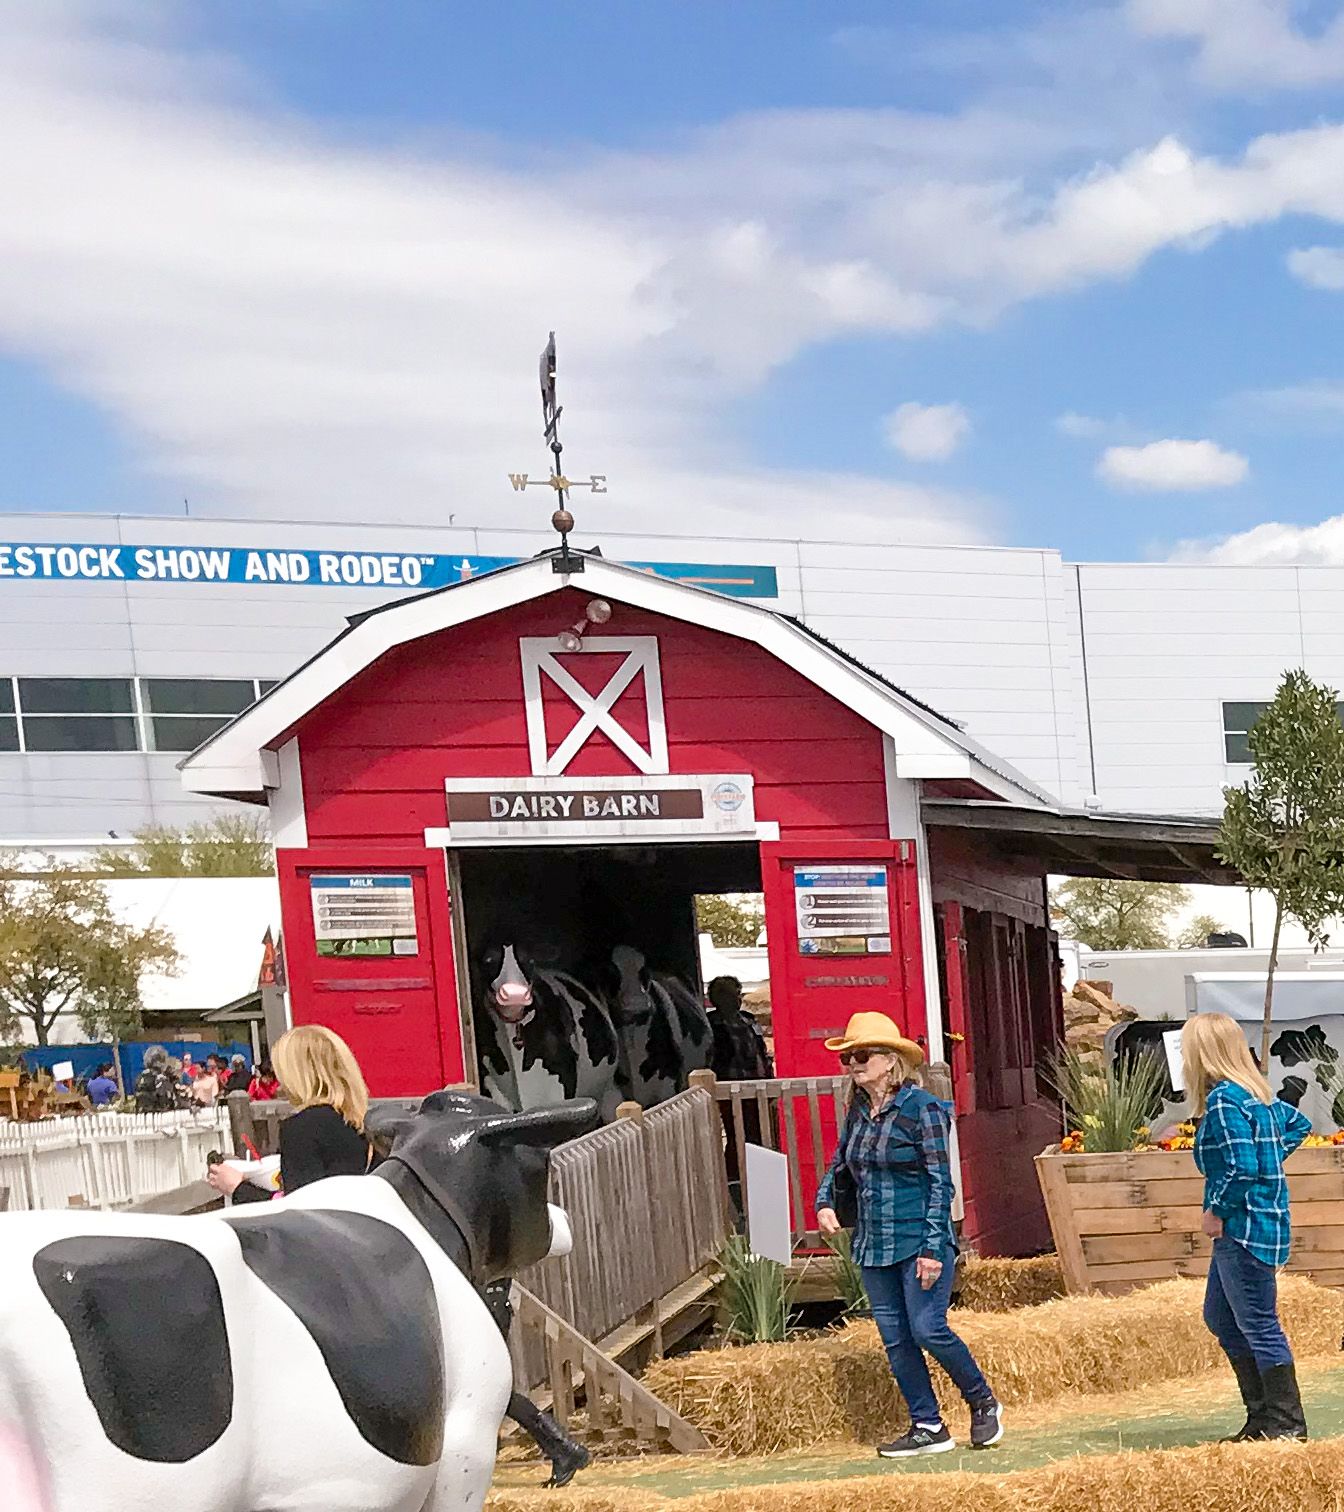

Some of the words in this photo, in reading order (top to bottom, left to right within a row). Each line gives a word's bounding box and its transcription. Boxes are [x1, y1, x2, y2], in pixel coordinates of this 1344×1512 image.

[134, 549, 231, 579] SHOW
[245, 552, 310, 581] AND
[489, 795, 574, 818] DAIRY
[583, 794, 660, 816] BARN
[349, 879, 374, 887] MILK
